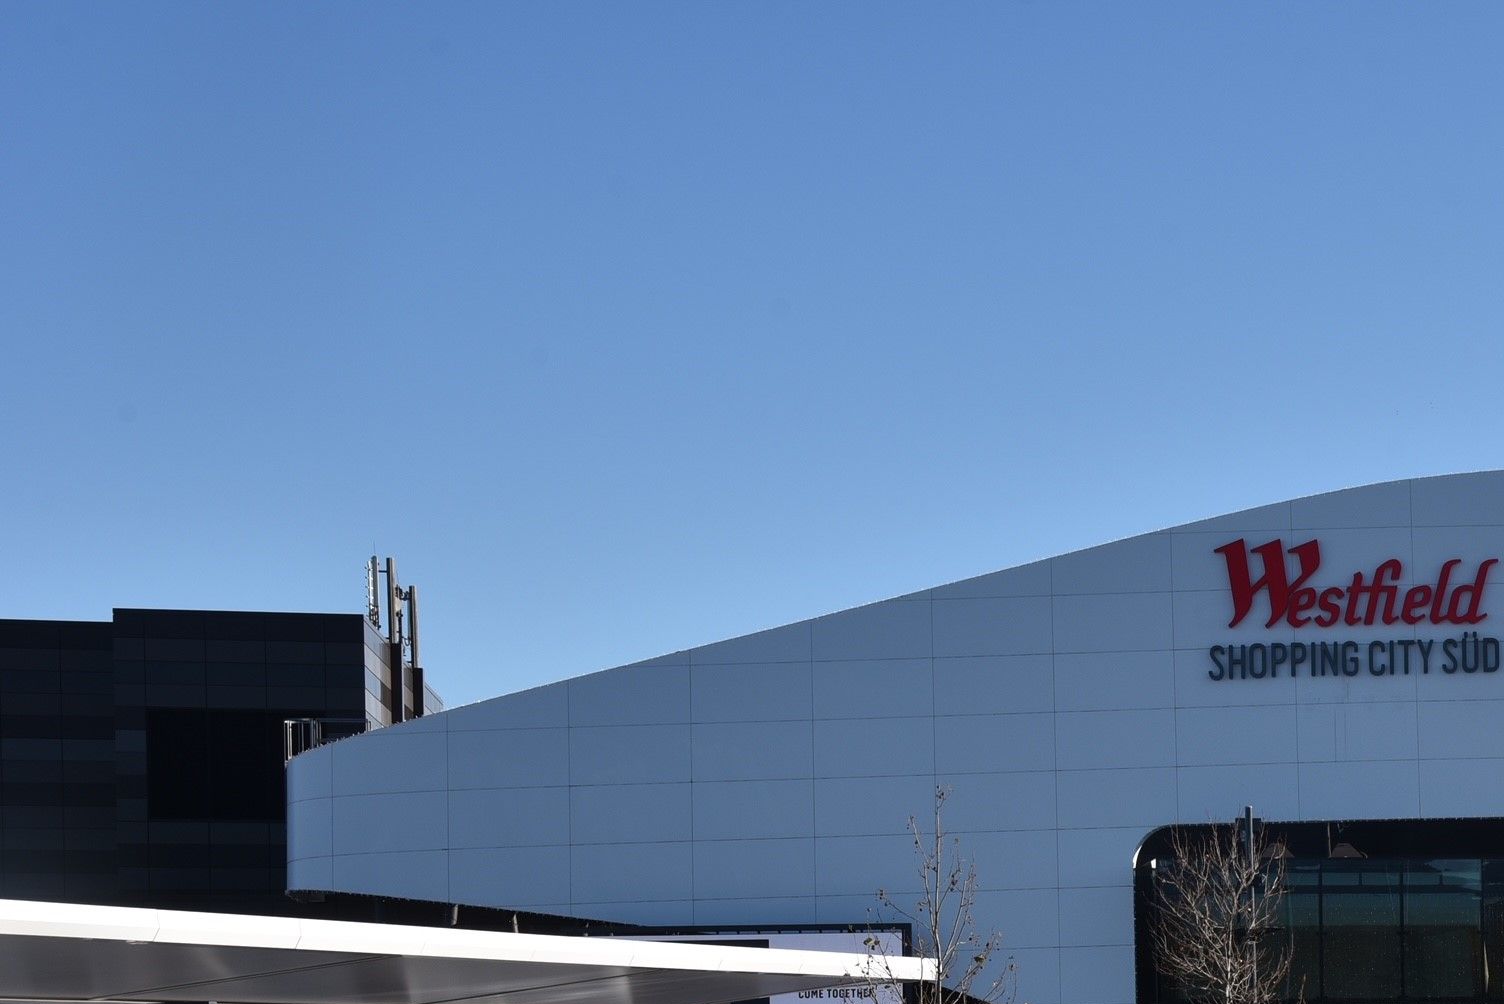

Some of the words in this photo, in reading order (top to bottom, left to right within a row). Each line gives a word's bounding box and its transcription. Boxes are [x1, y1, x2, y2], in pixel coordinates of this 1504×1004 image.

[1213, 538, 1499, 629] Westfield
[1208, 641, 1359, 681] SHOPPING
[1367, 639, 1434, 677] CITY
[1441, 631, 1501, 674] SÜD
